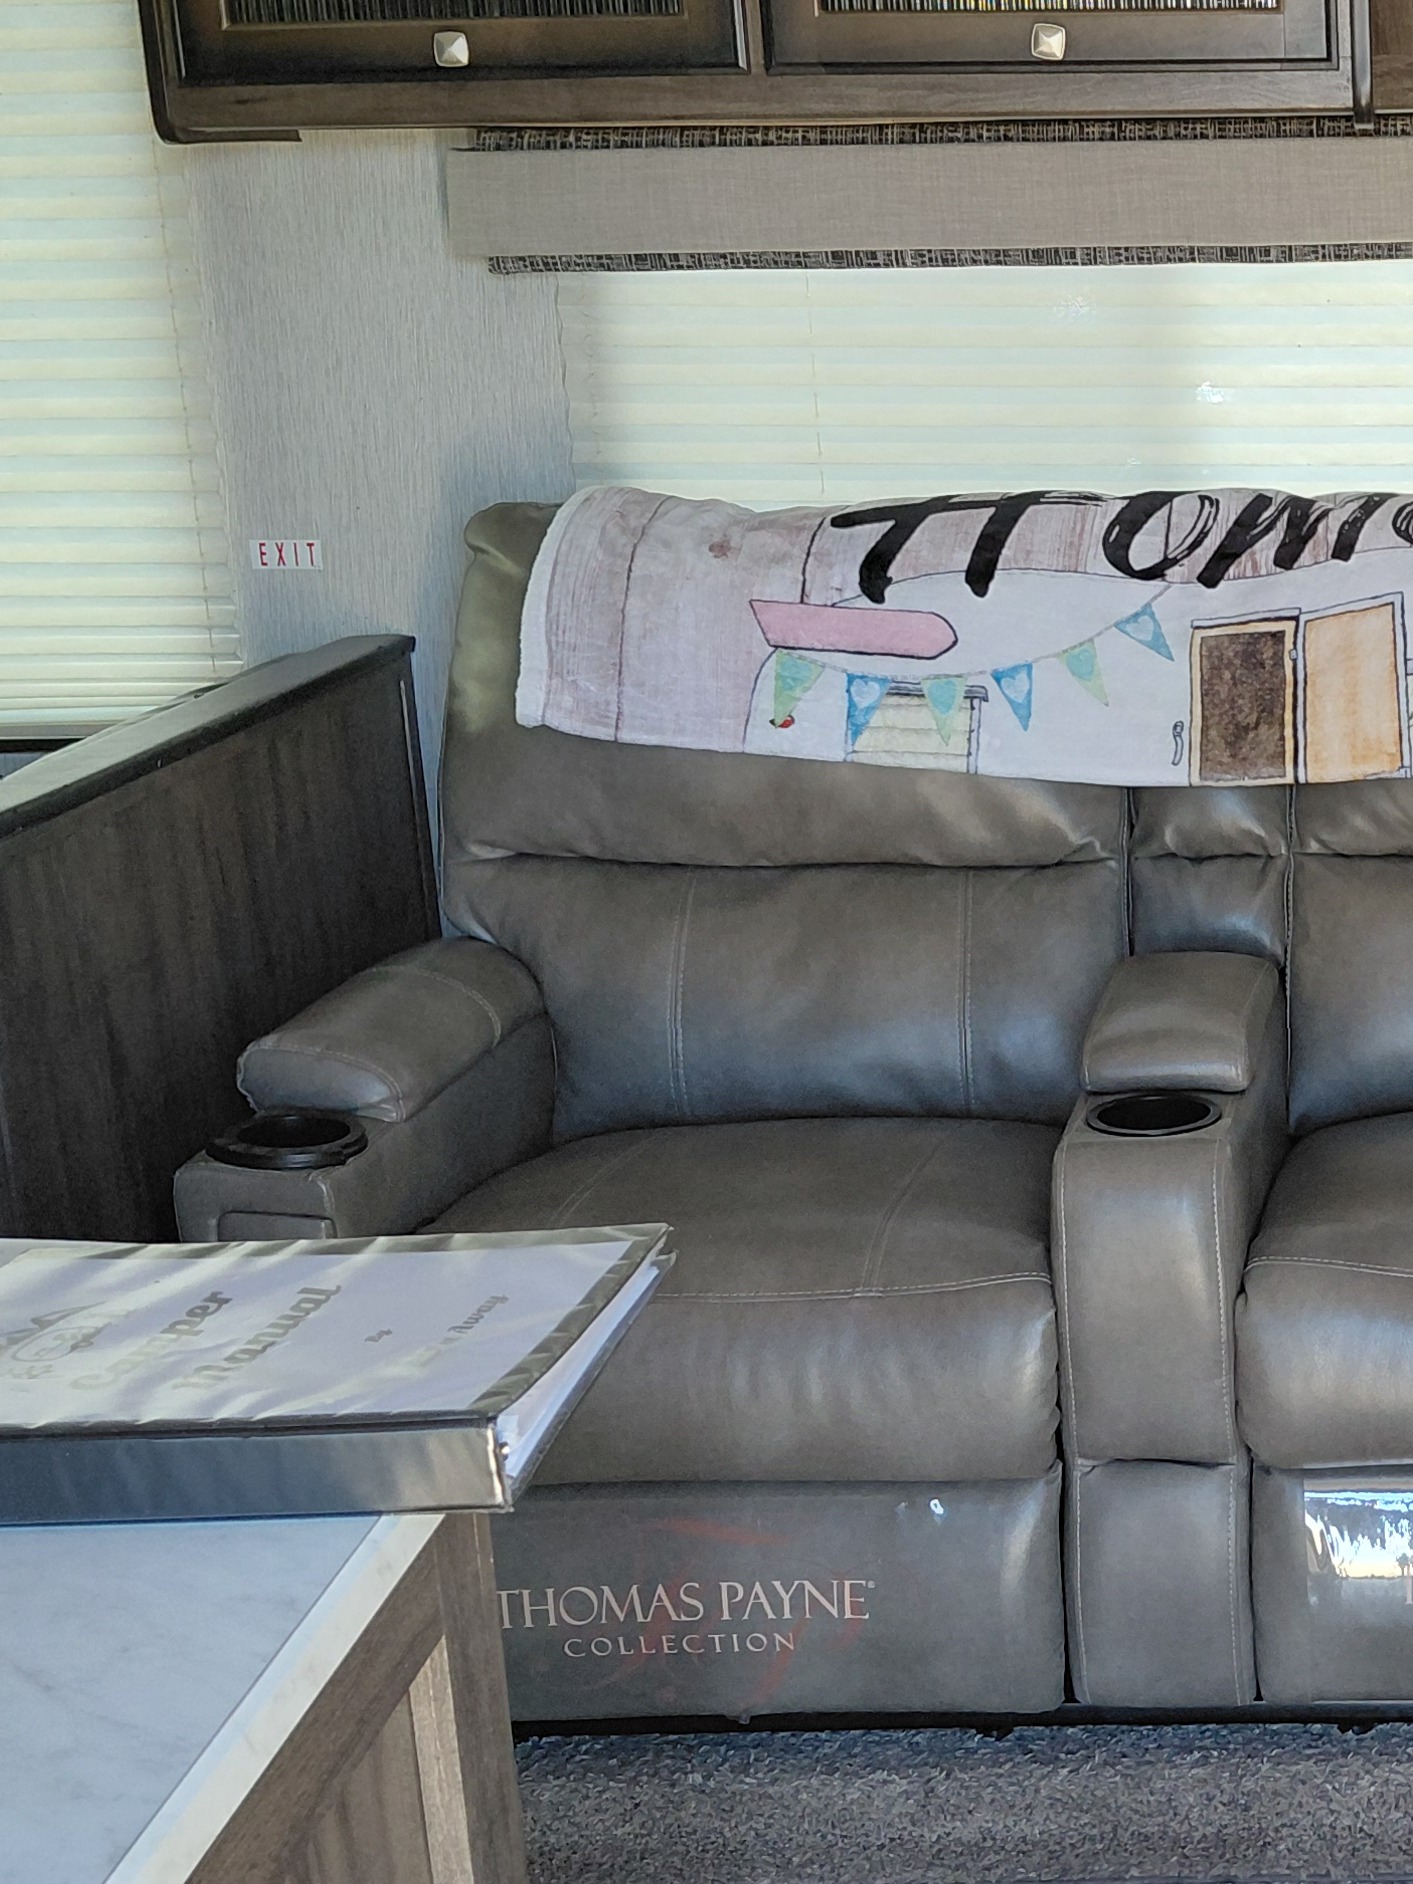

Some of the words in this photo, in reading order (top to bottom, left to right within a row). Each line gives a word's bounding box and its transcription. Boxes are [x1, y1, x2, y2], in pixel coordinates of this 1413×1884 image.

[258, 542, 316, 567] EXIT
[171, 1284, 342, 1391] Manual
[496, 1581, 705, 1629] THOMAS
[563, 1631, 796, 1658] COLLECTION
